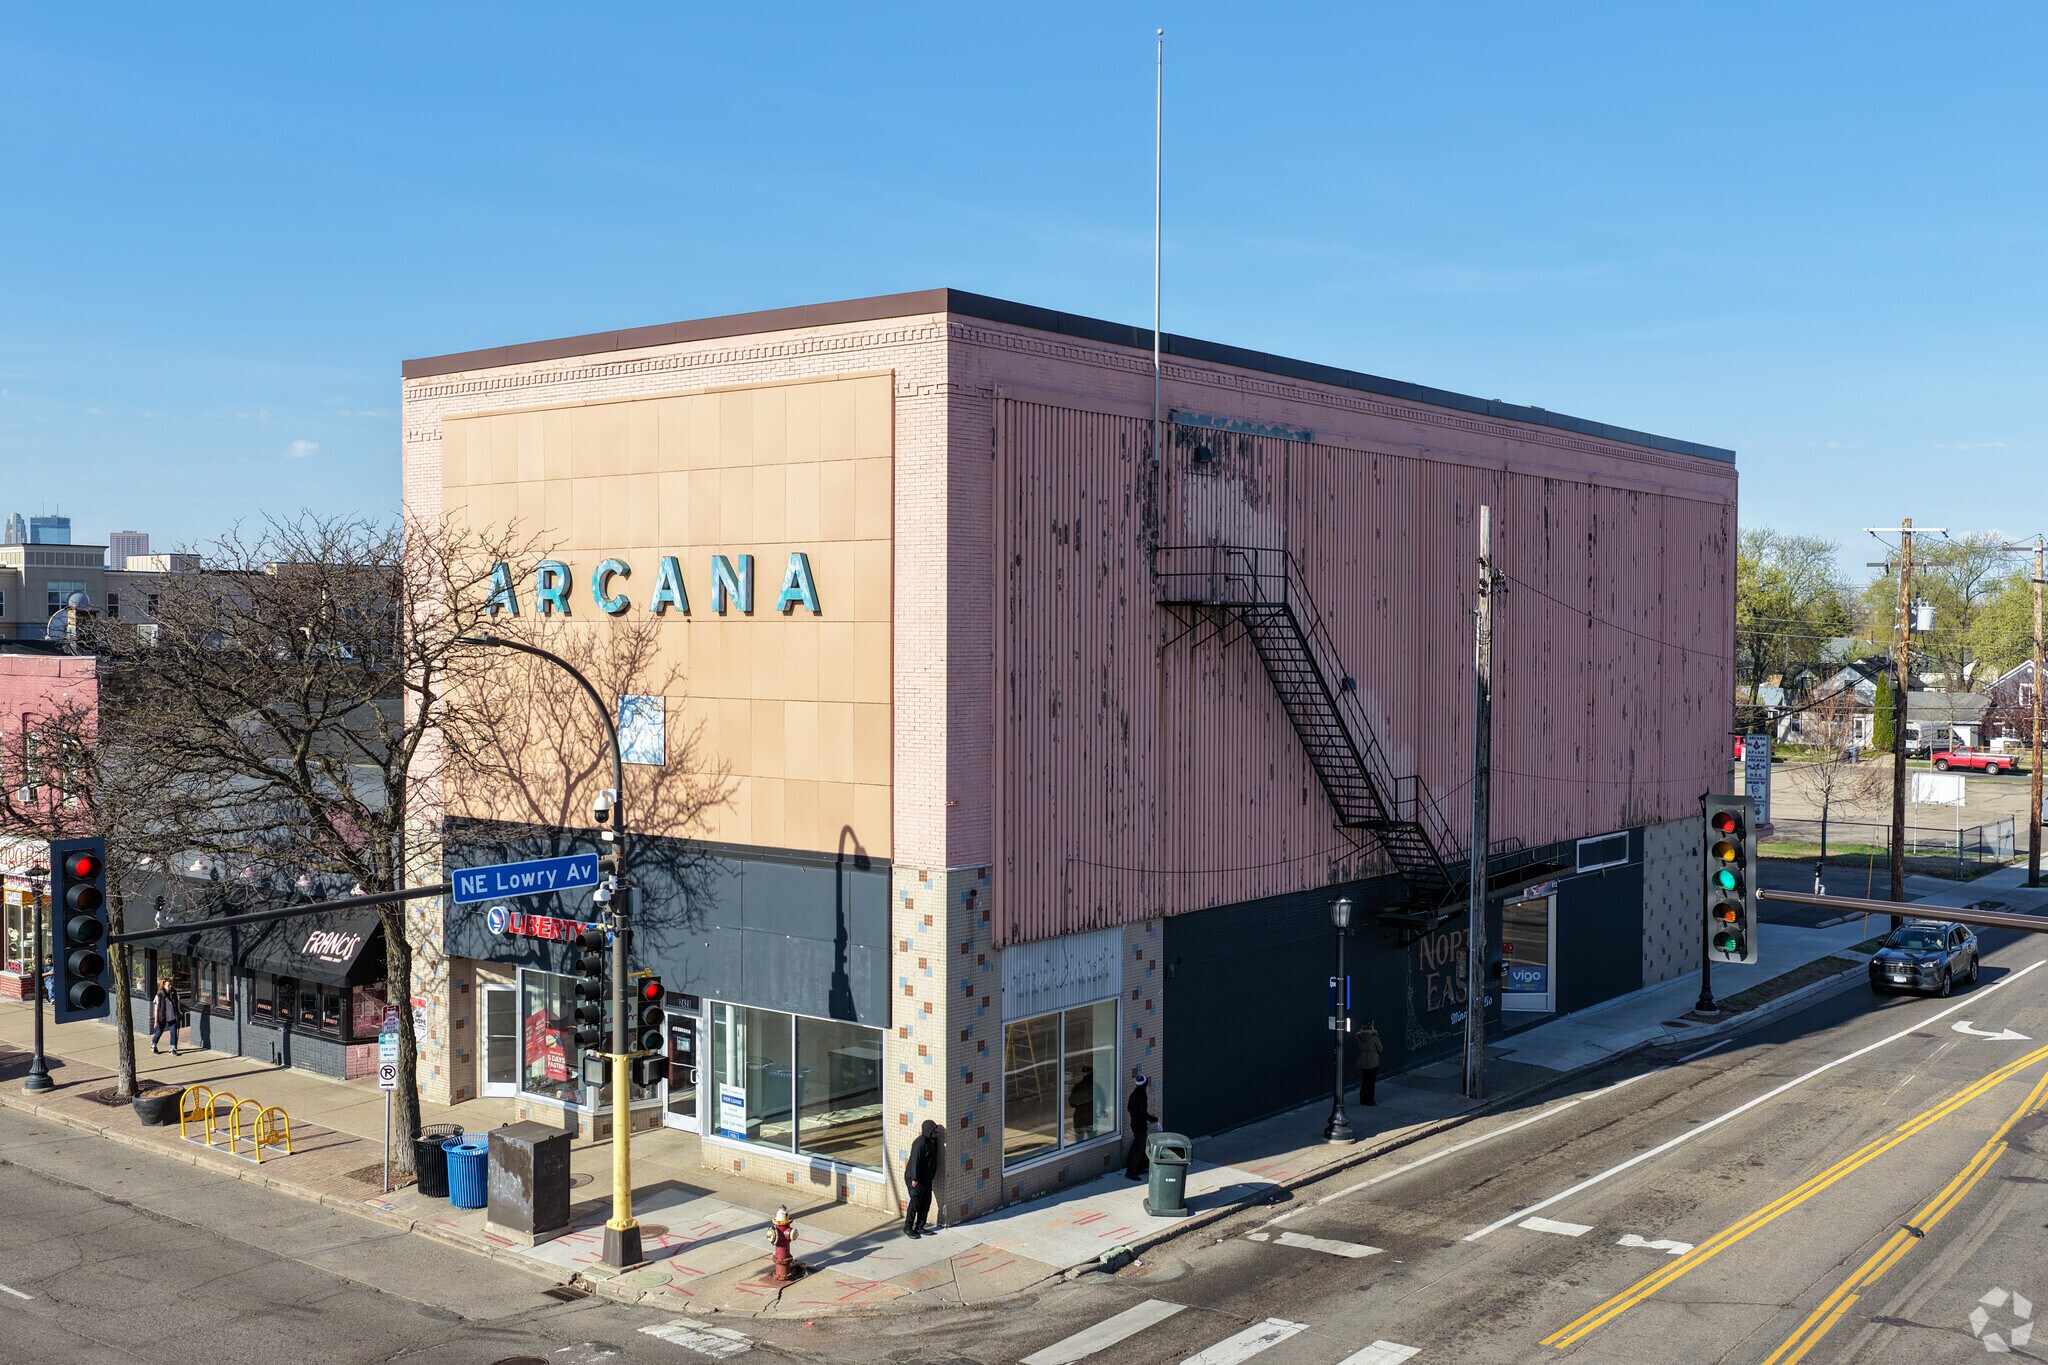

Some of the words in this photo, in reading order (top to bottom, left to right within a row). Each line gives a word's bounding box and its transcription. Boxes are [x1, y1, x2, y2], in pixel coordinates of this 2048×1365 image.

[484, 551, 823, 618] ARCANA
[461, 874, 488, 895] NE
[497, 868, 557, 890] Lowry
[566, 863, 592, 881] Av
[508, 912, 587, 942] LIBERTY
[1512, 969, 1541, 983] vigo
[547, 1061, 565, 1070] FASTER
[551, 1055, 566, 1064] DAYS
[731, 1098, 742, 1106] LEASE
